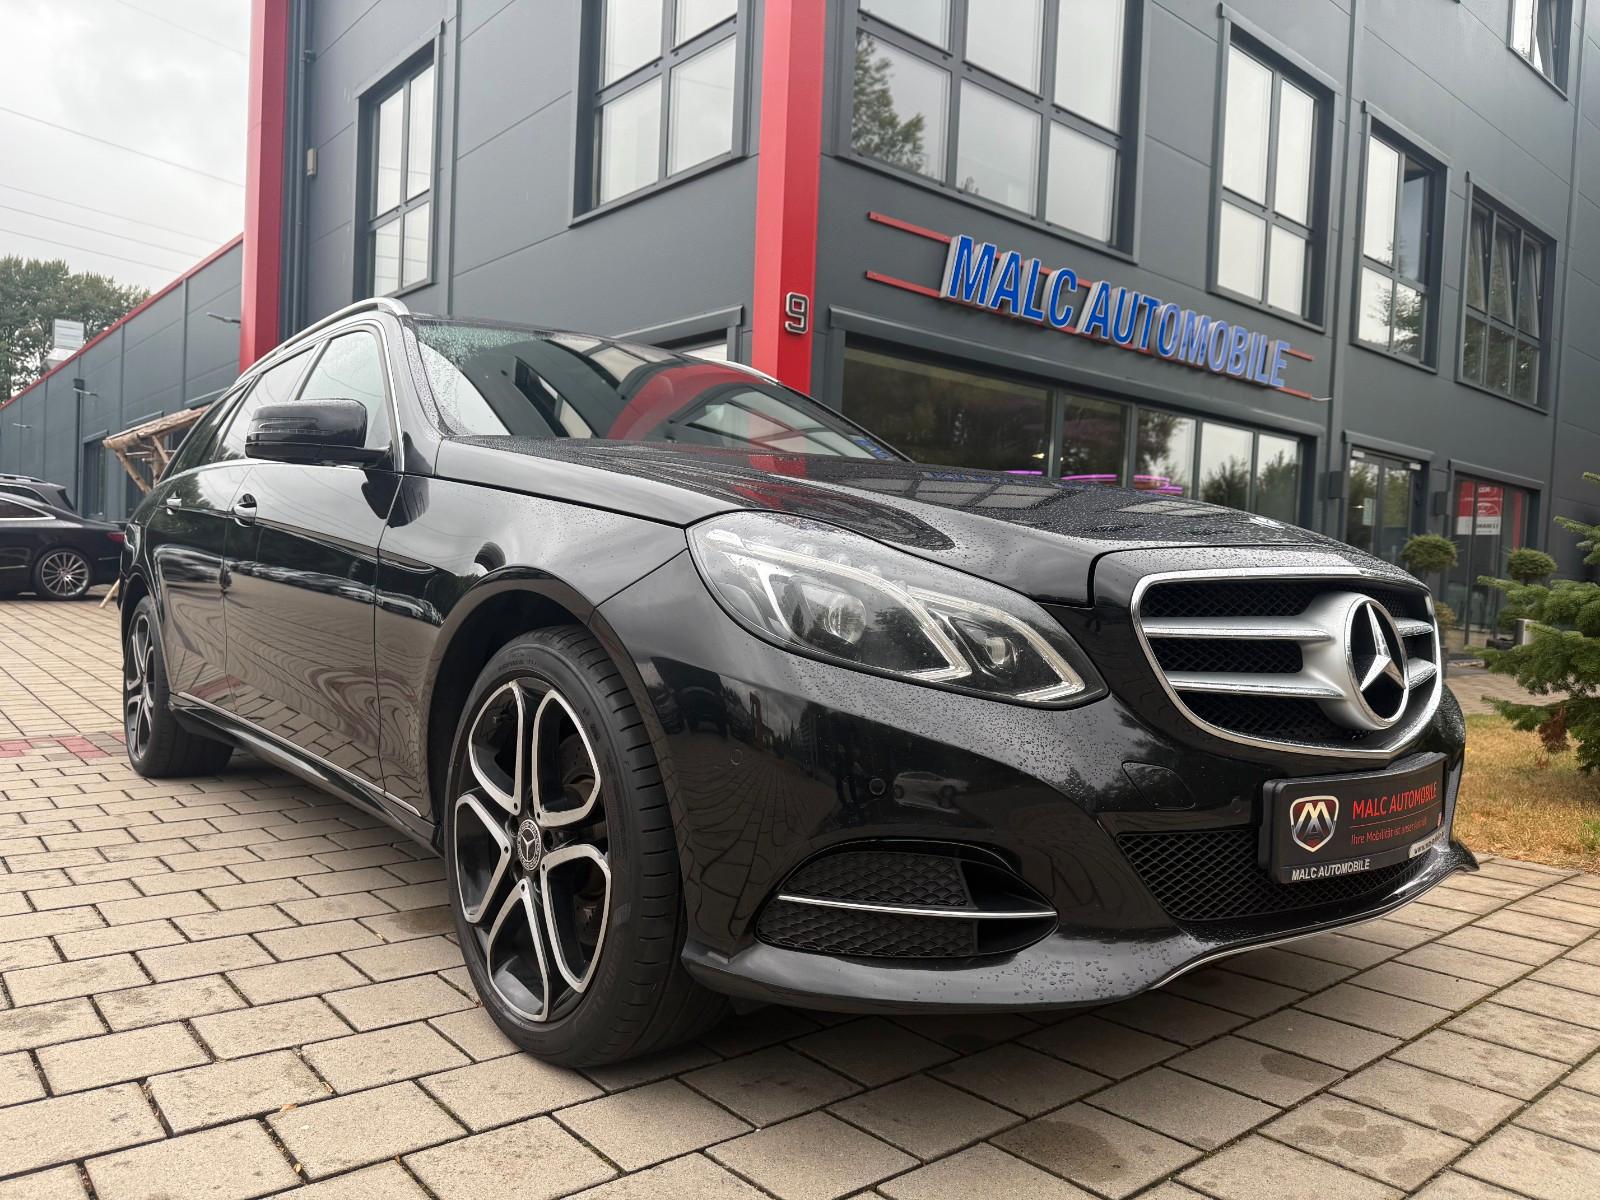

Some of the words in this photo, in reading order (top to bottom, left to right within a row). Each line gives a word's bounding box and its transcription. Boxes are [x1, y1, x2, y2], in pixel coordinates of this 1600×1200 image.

[785, 292, 809, 333] 9
[941, 235, 1077, 328] MALC
[1078, 281, 1291, 387] AUTOMOBILE
[1352, 797, 1388, 819] MALC
[1390, 783, 1437, 811] AUTOMOBILE
[1351, 834, 1365, 845] Ihre
[1292, 867, 1317, 881] MALC
[1318, 858, 1371, 877] AUTOMOBILE
